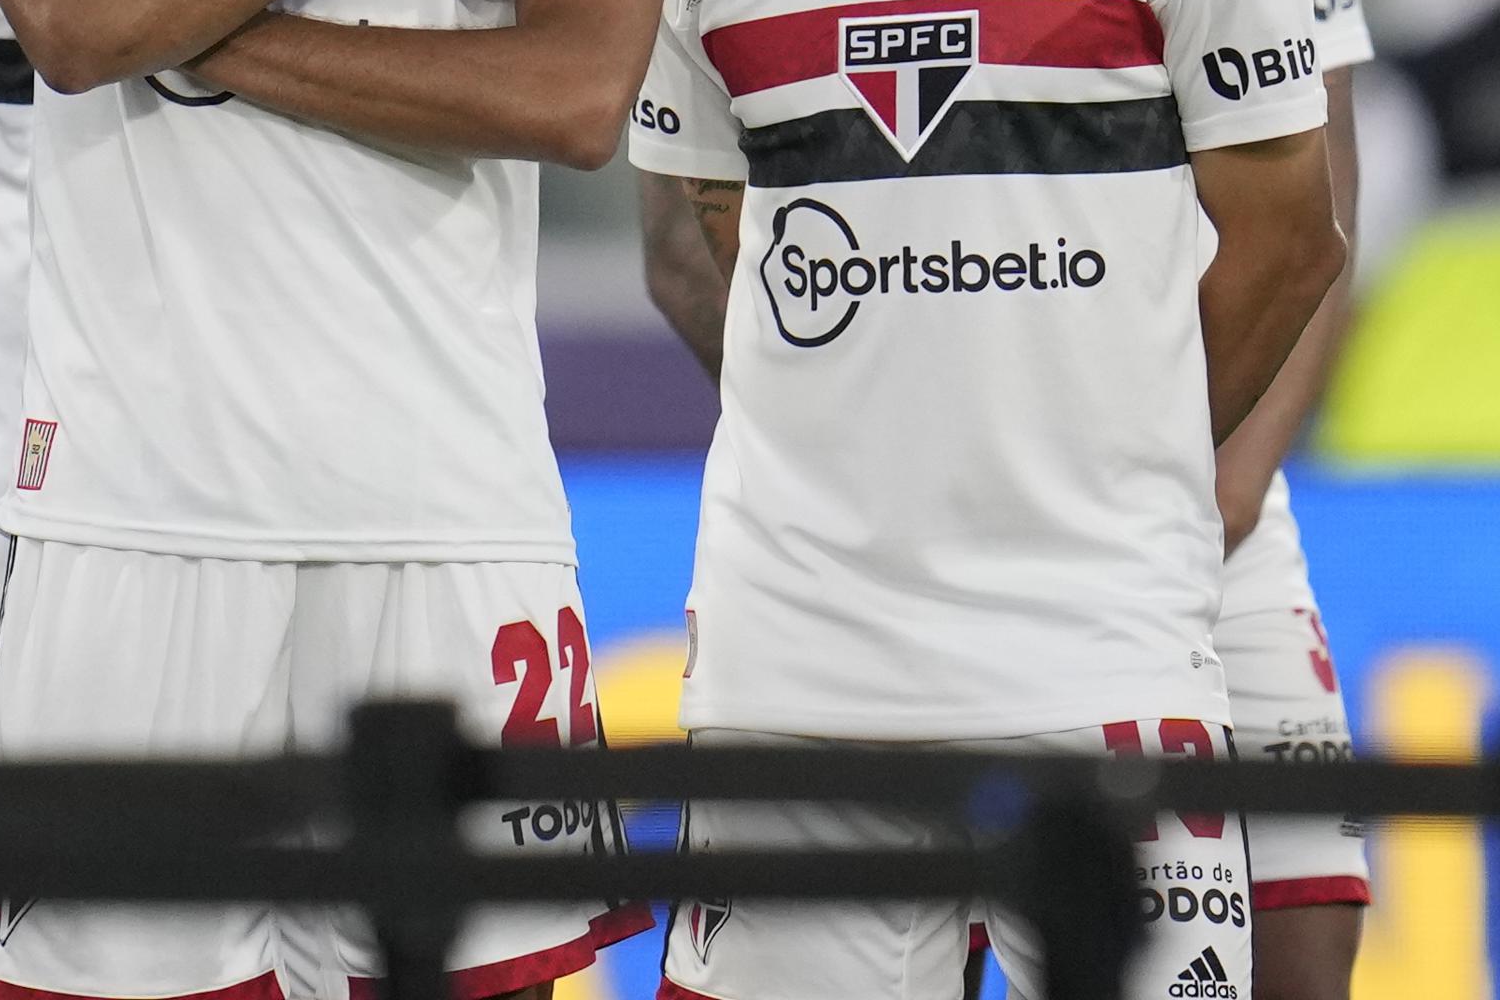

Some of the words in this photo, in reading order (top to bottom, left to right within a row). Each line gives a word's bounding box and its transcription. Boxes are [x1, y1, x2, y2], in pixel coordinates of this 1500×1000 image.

[849, 23, 966, 60] SPFC
[781, 237, 1107, 311] Sportsbet.io
[491, 606, 597, 750] 22
[1136, 860, 1204, 881] artão
[1212, 862, 1233, 884] de
[1134, 886, 1247, 929] ODOS
[1168, 979, 1238, 1000] adidas
